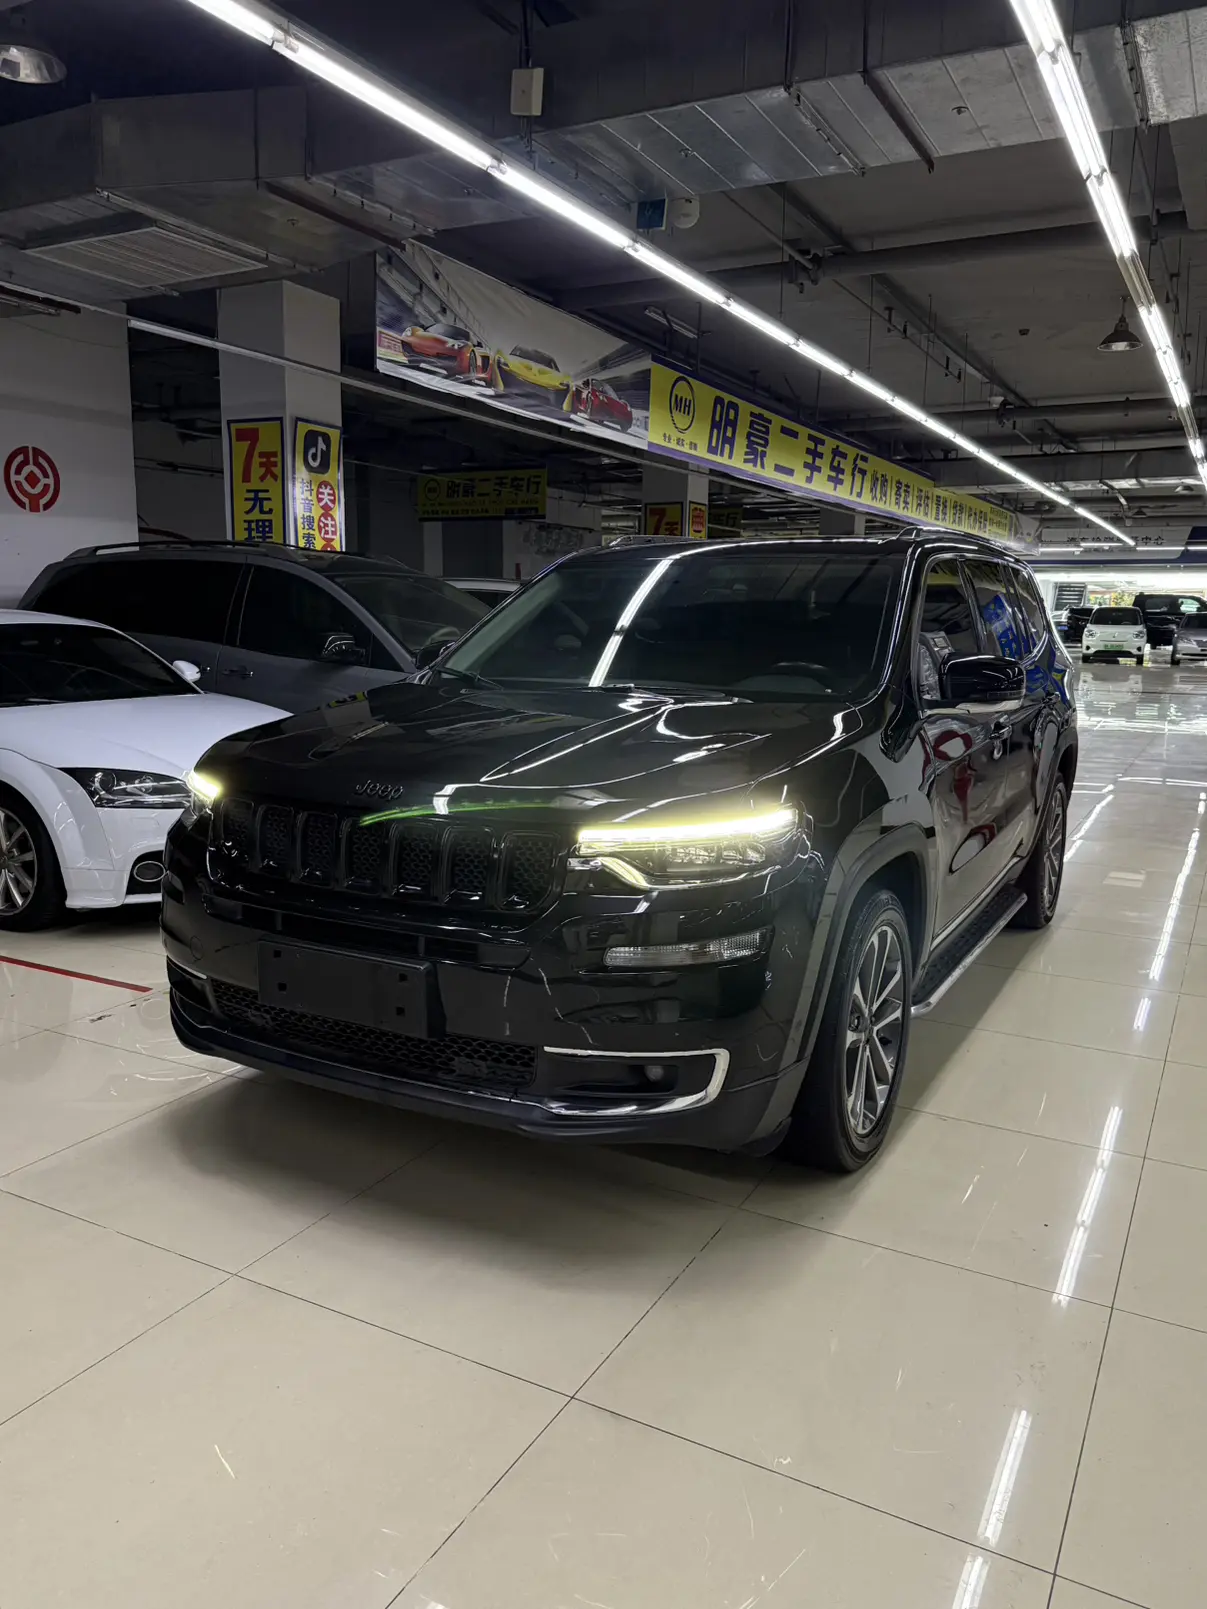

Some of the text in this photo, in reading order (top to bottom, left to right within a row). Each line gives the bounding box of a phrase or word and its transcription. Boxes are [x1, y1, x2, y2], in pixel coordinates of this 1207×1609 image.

[673, 394, 692, 416] MH
[235, 427, 279, 484] 7天
[707, 395, 869, 499] 明豪二手车行
[299, 478, 316, 549] 抖音搜索
[317, 484, 337, 549] 关注
[355, 779, 405, 801] Jeep
